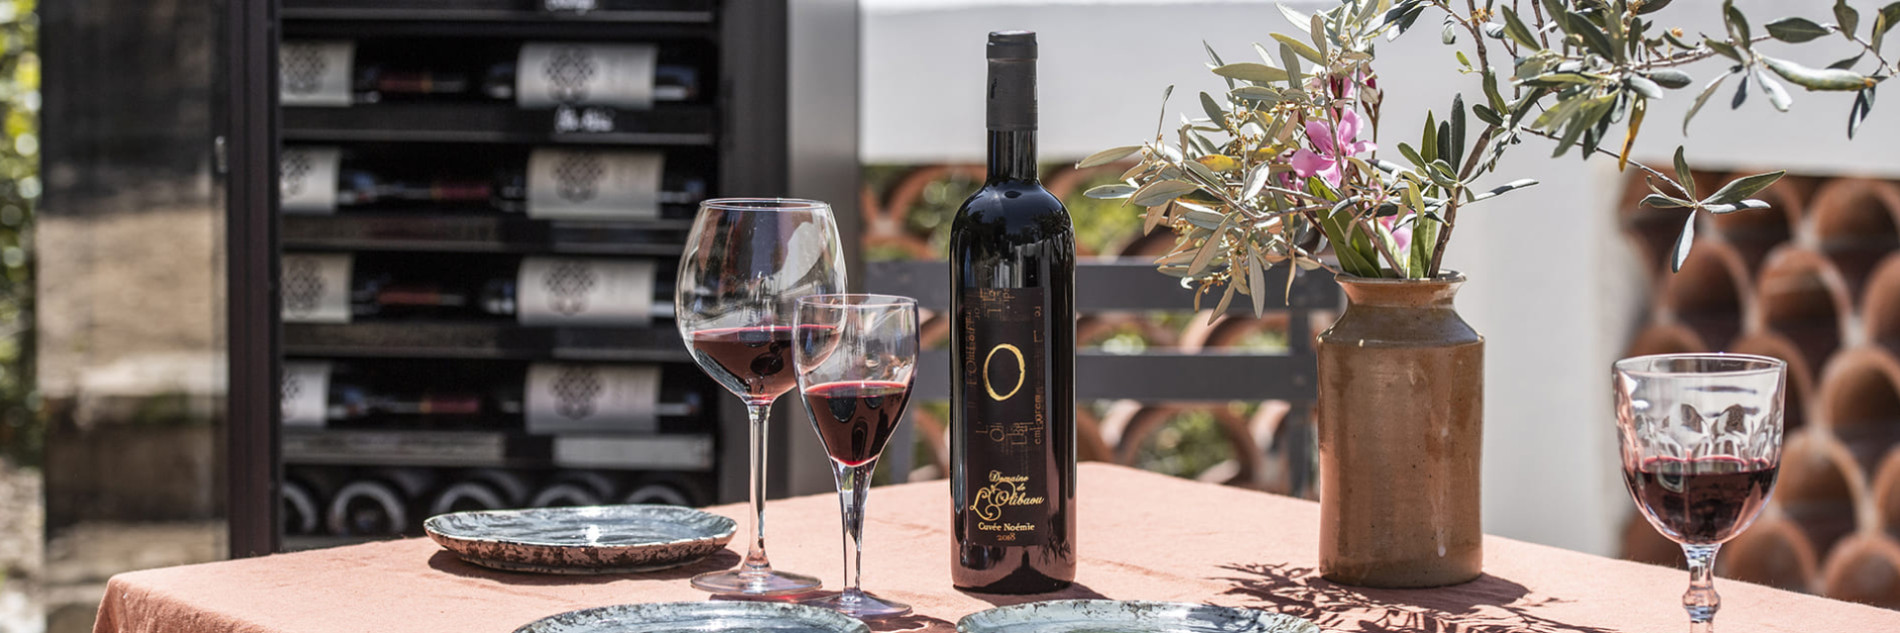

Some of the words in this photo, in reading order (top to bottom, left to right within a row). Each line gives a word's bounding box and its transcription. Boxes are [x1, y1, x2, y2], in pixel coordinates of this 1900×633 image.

[989, 470, 1029, 482] Domaine
[1016, 483, 1026, 491] de
[978, 522, 1002, 531] Cuvée
[1004, 522, 1035, 531] Noémie
[997, 533, 1016, 541] 2018
